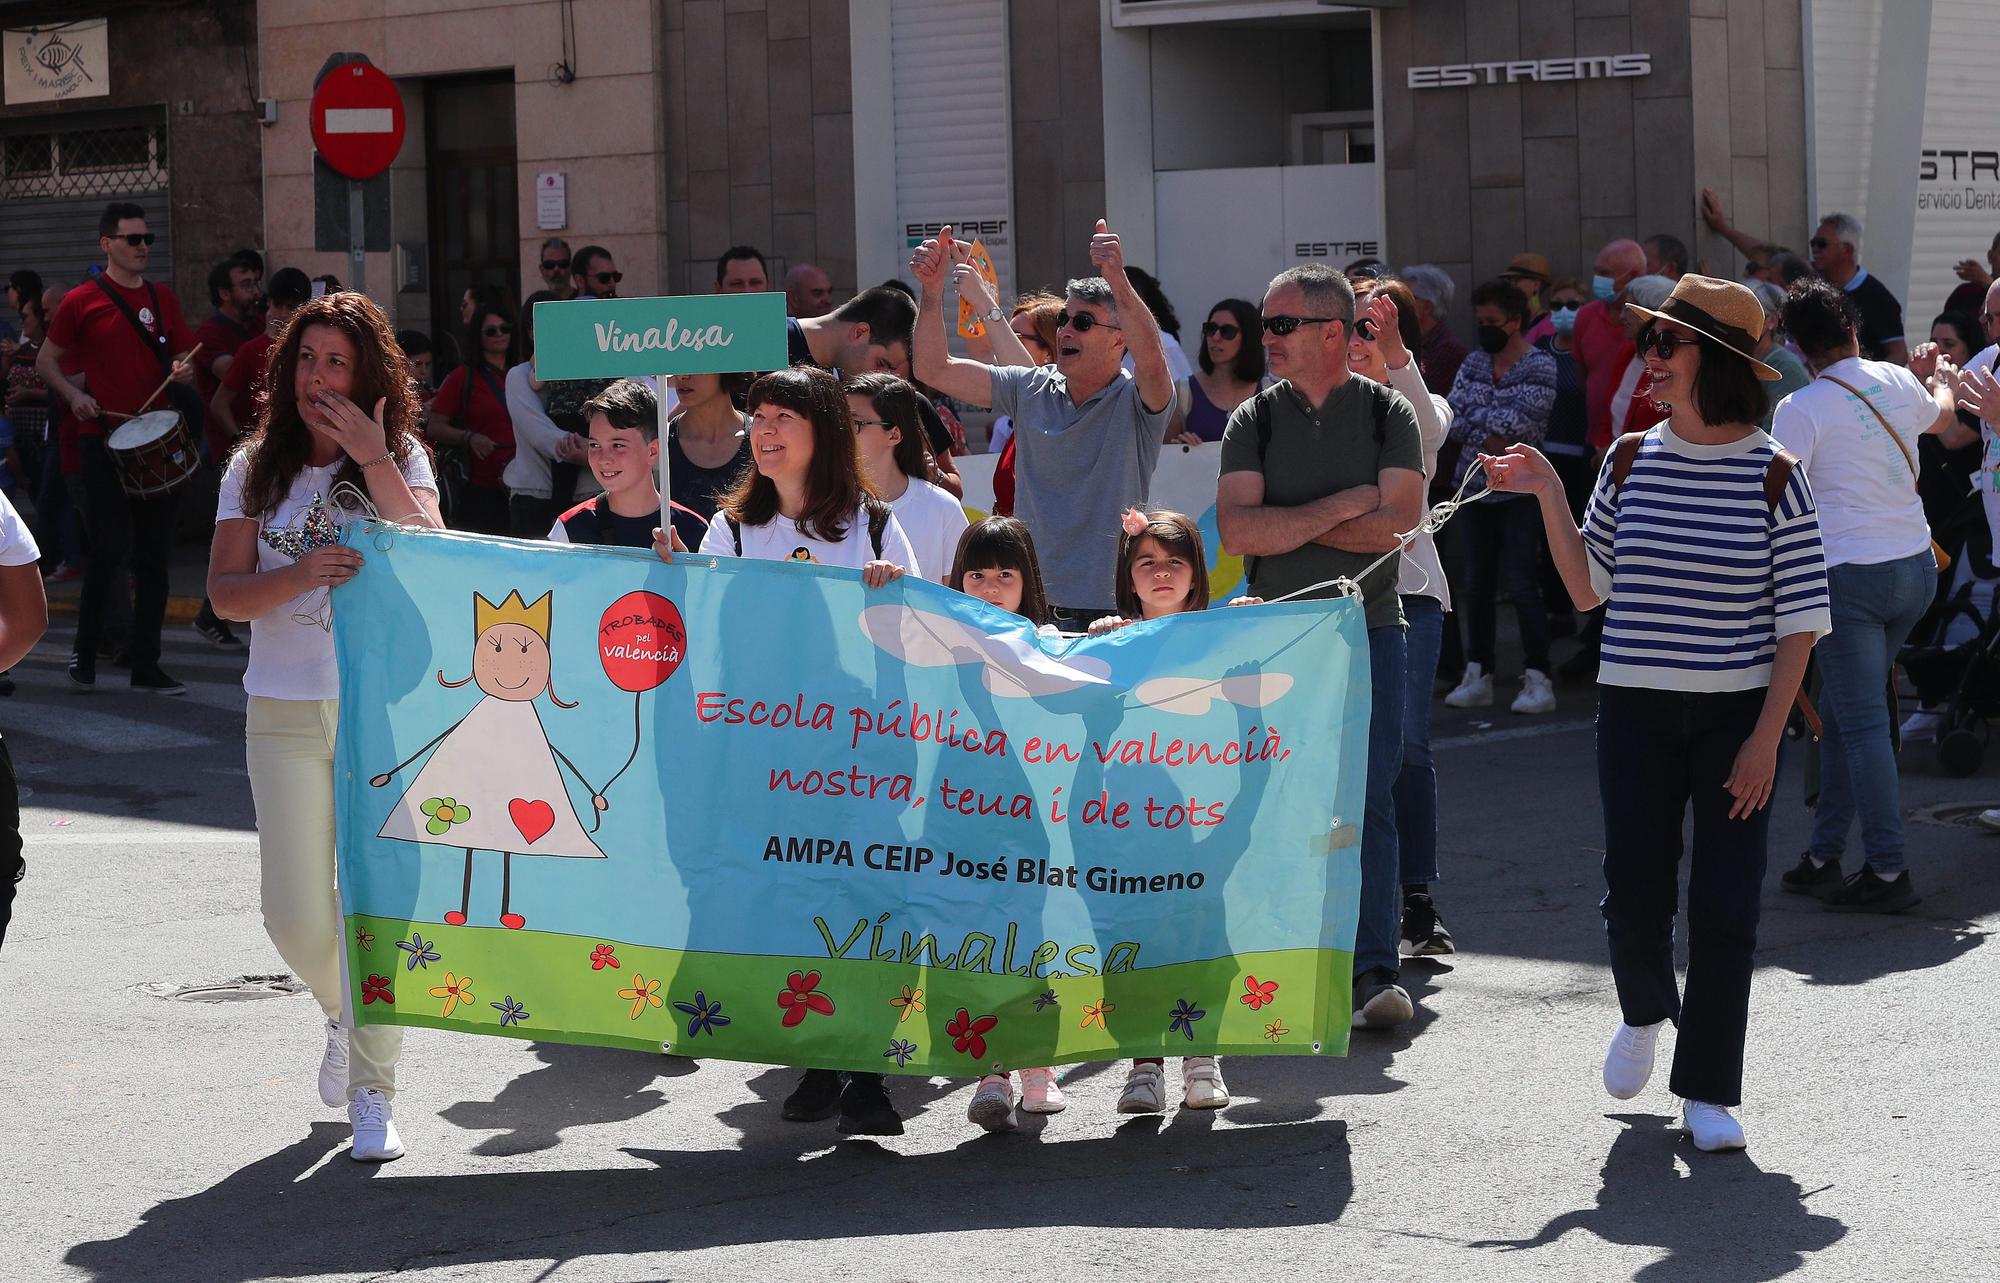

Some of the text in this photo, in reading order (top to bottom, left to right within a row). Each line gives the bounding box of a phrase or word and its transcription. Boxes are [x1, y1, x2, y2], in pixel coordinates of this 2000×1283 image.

[1407, 53, 1651, 88] ESTREMS
[1295, 242, 1378, 256] ESTRE
[594, 318, 733, 352] Vinalesa
[600, 615, 684, 642] TROBADES
[635, 633, 651, 644] pel
[604, 644, 679, 662] valencià
[696, 692, 1292, 768] Escola pública en valencià,
[767, 765, 925, 809] nostra,
[940, 778, 1032, 820] teua
[1081, 790, 1130, 829] de
[1143, 797, 1225, 830] tots
[763, 836, 1205, 894] AMPA CEIP José Blat Gimeno
[813, 911, 1141, 980] Vinalesa
